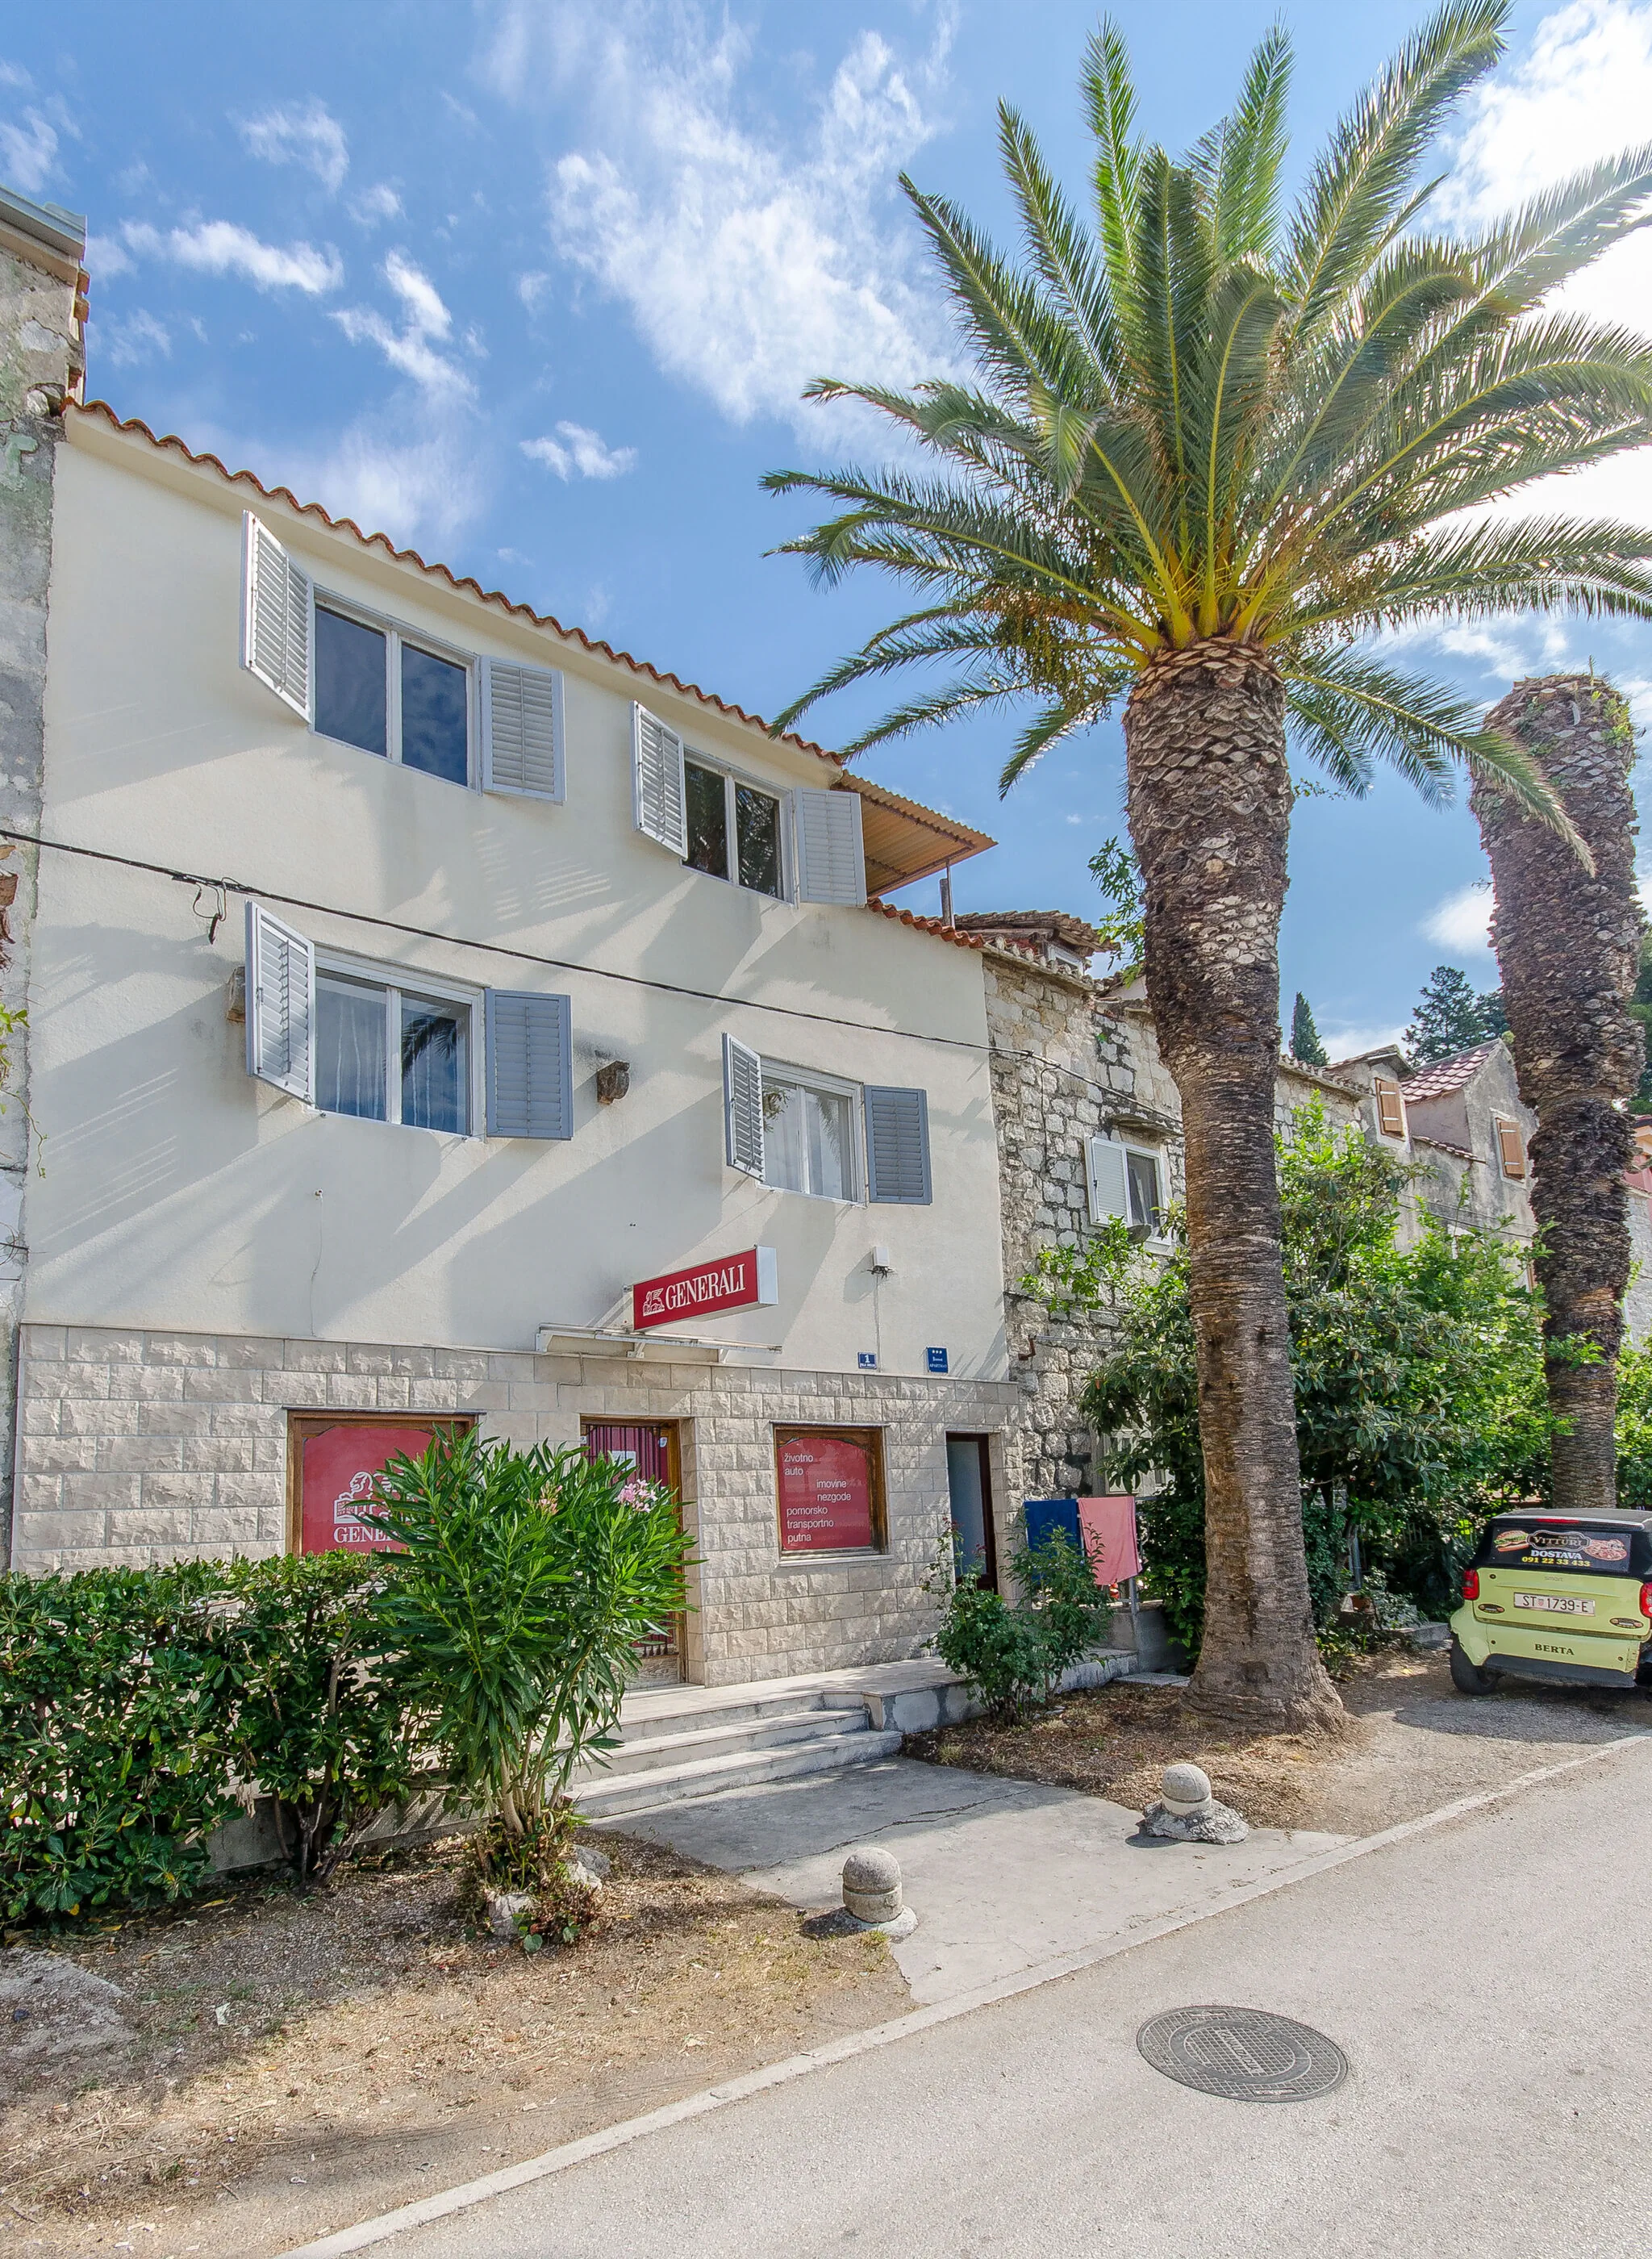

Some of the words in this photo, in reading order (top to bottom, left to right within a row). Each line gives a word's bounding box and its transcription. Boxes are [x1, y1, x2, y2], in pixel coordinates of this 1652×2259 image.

[665, 1263, 745, 1310] GENERALI
[865, 1355, 870, 1363] 1
[784, 1453, 814, 1463] životno
[784, 1467, 804, 1476] auto
[816, 1479, 847, 1489] imovine
[817, 1492, 852, 1503] nezgode
[786, 1505, 828, 1518] pomorsko
[786, 1518, 834, 1530] transportno
[787, 1533, 811, 1544] putna
[1533, 1536, 1582, 1547] VITTURI
[1530, 1550, 1583, 1560] DOSTAVA
[1571, 1560, 1591, 1568] 433
[1522, 1595, 1537, 1607] ST
[1546, 1597, 1588, 1613] 1739-E
[1534, 1643, 1575, 1656] BERTA
